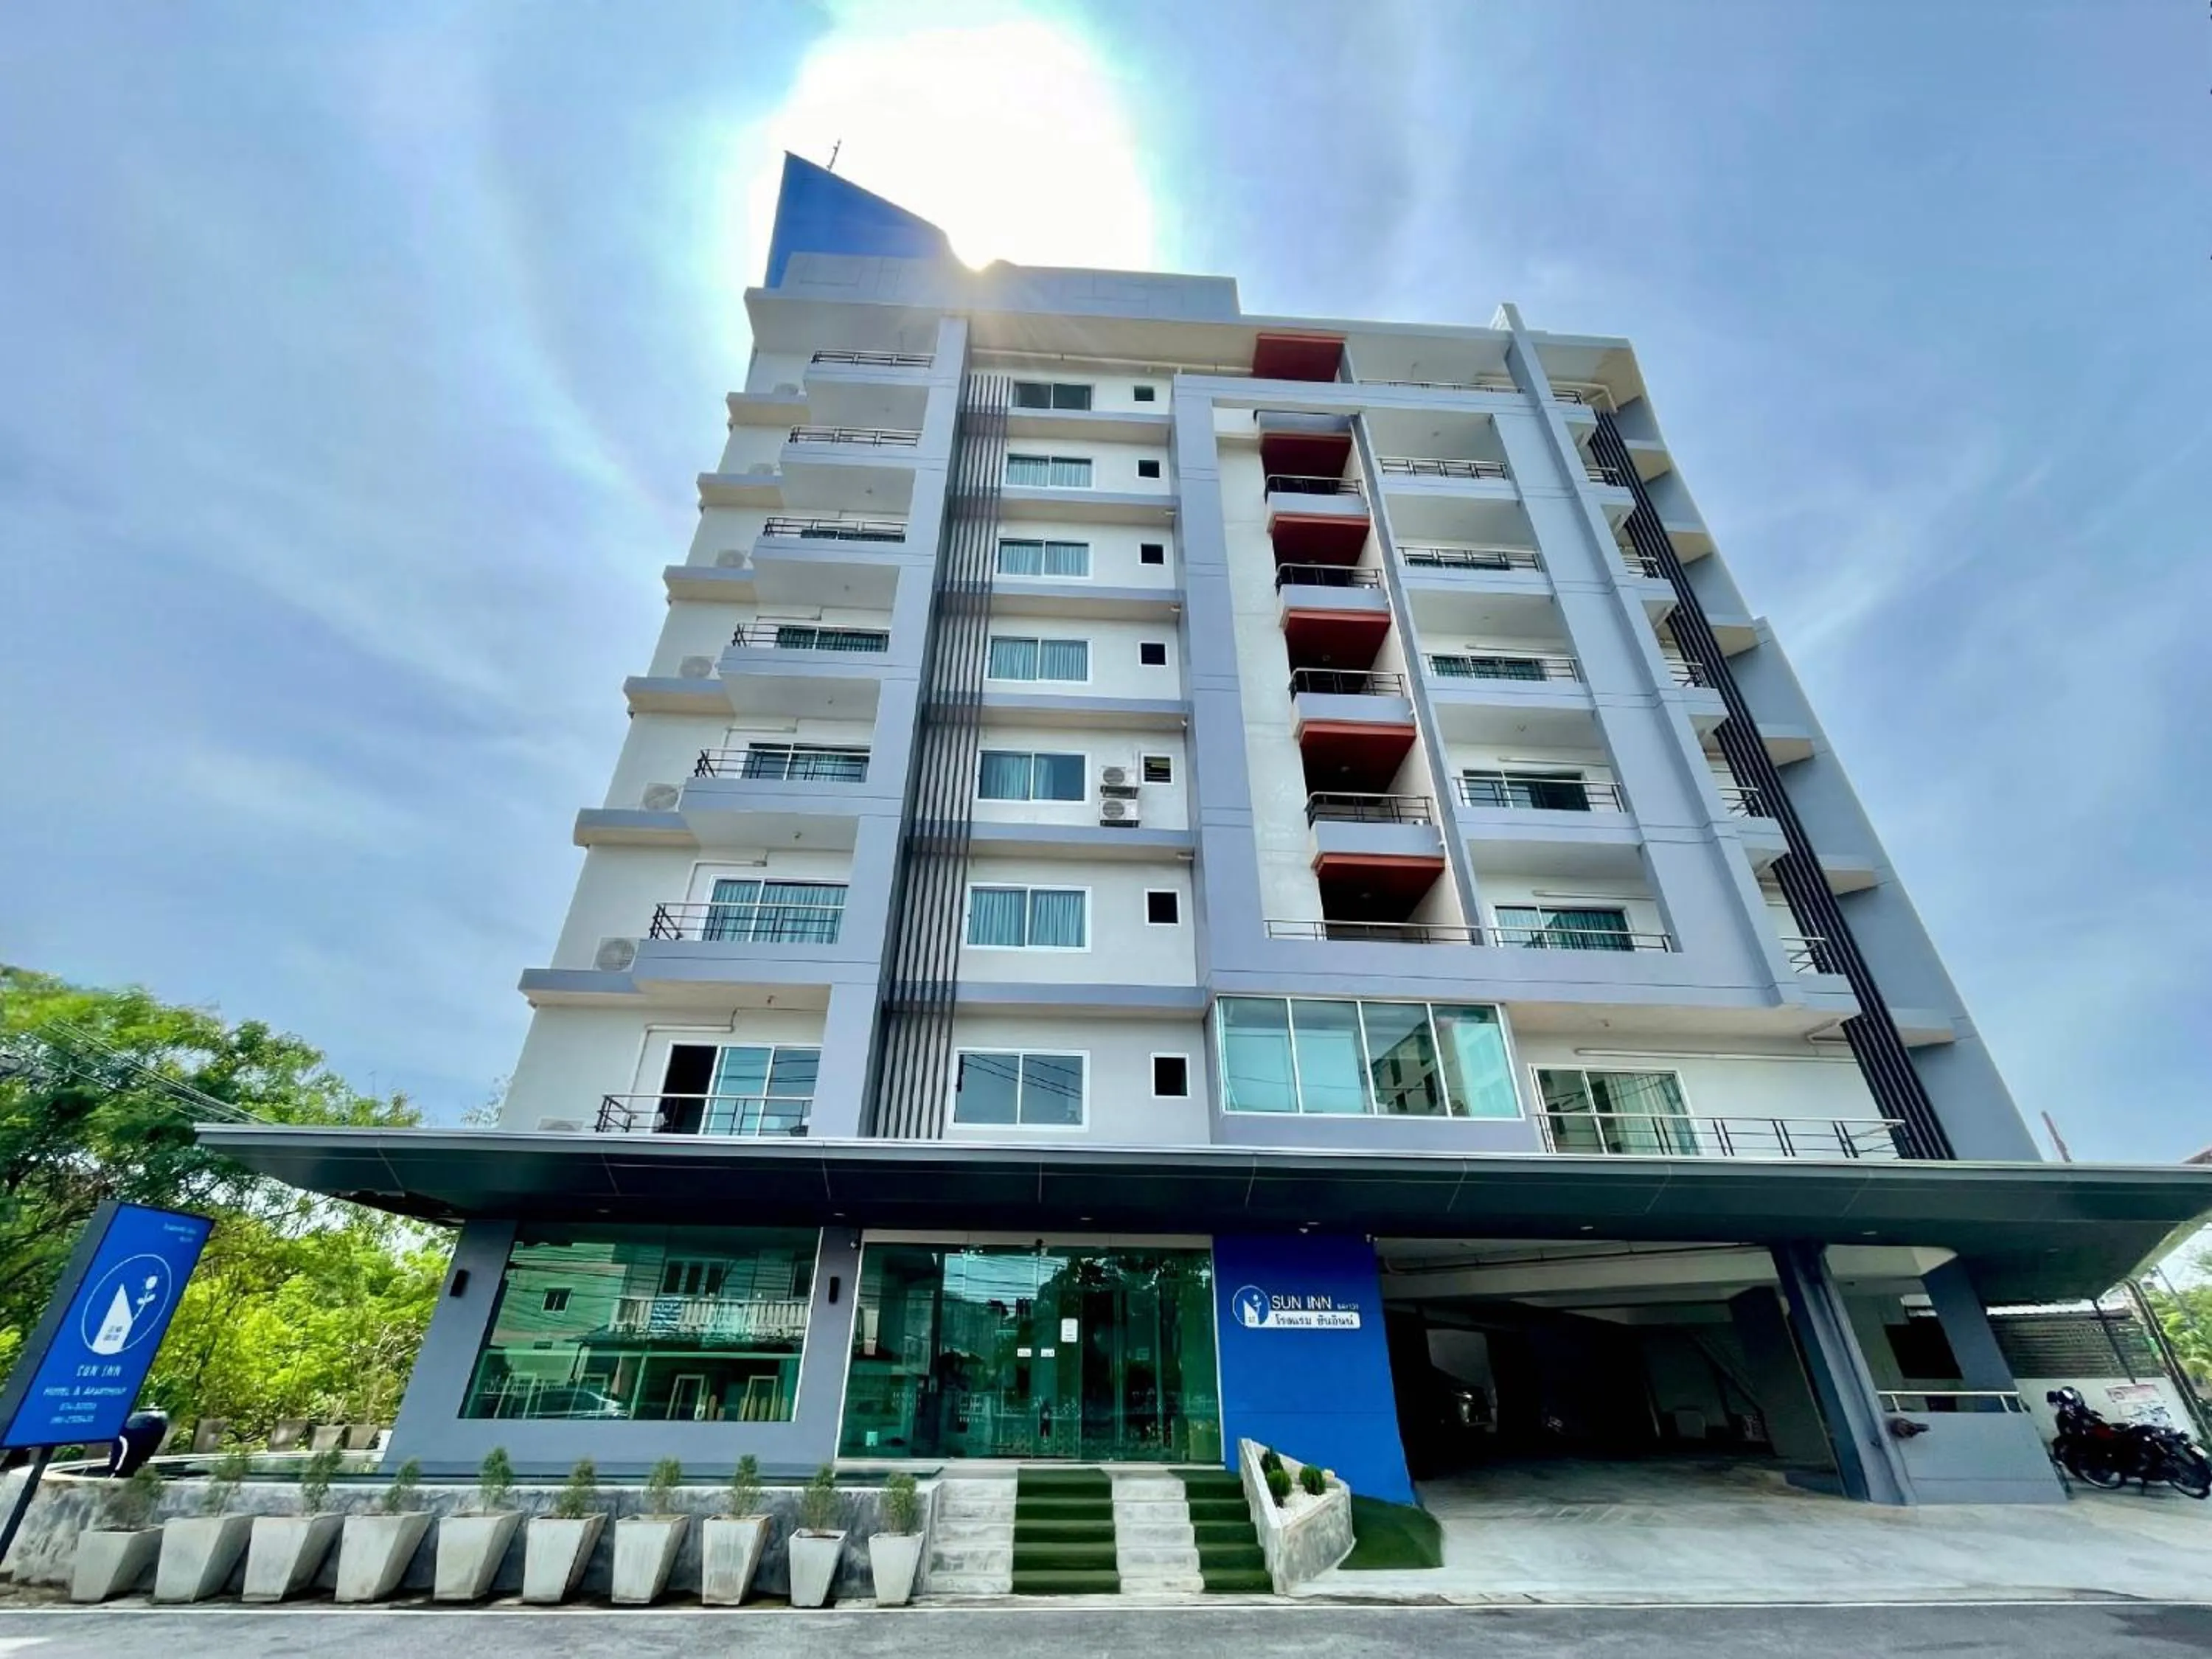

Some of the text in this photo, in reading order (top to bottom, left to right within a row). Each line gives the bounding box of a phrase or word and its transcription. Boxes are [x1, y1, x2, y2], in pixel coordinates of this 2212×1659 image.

[1272, 1295, 1301, 1310] SUN
[1307, 1295, 1332, 1310] INN
[76, 1364, 122, 1377] SUN INN
